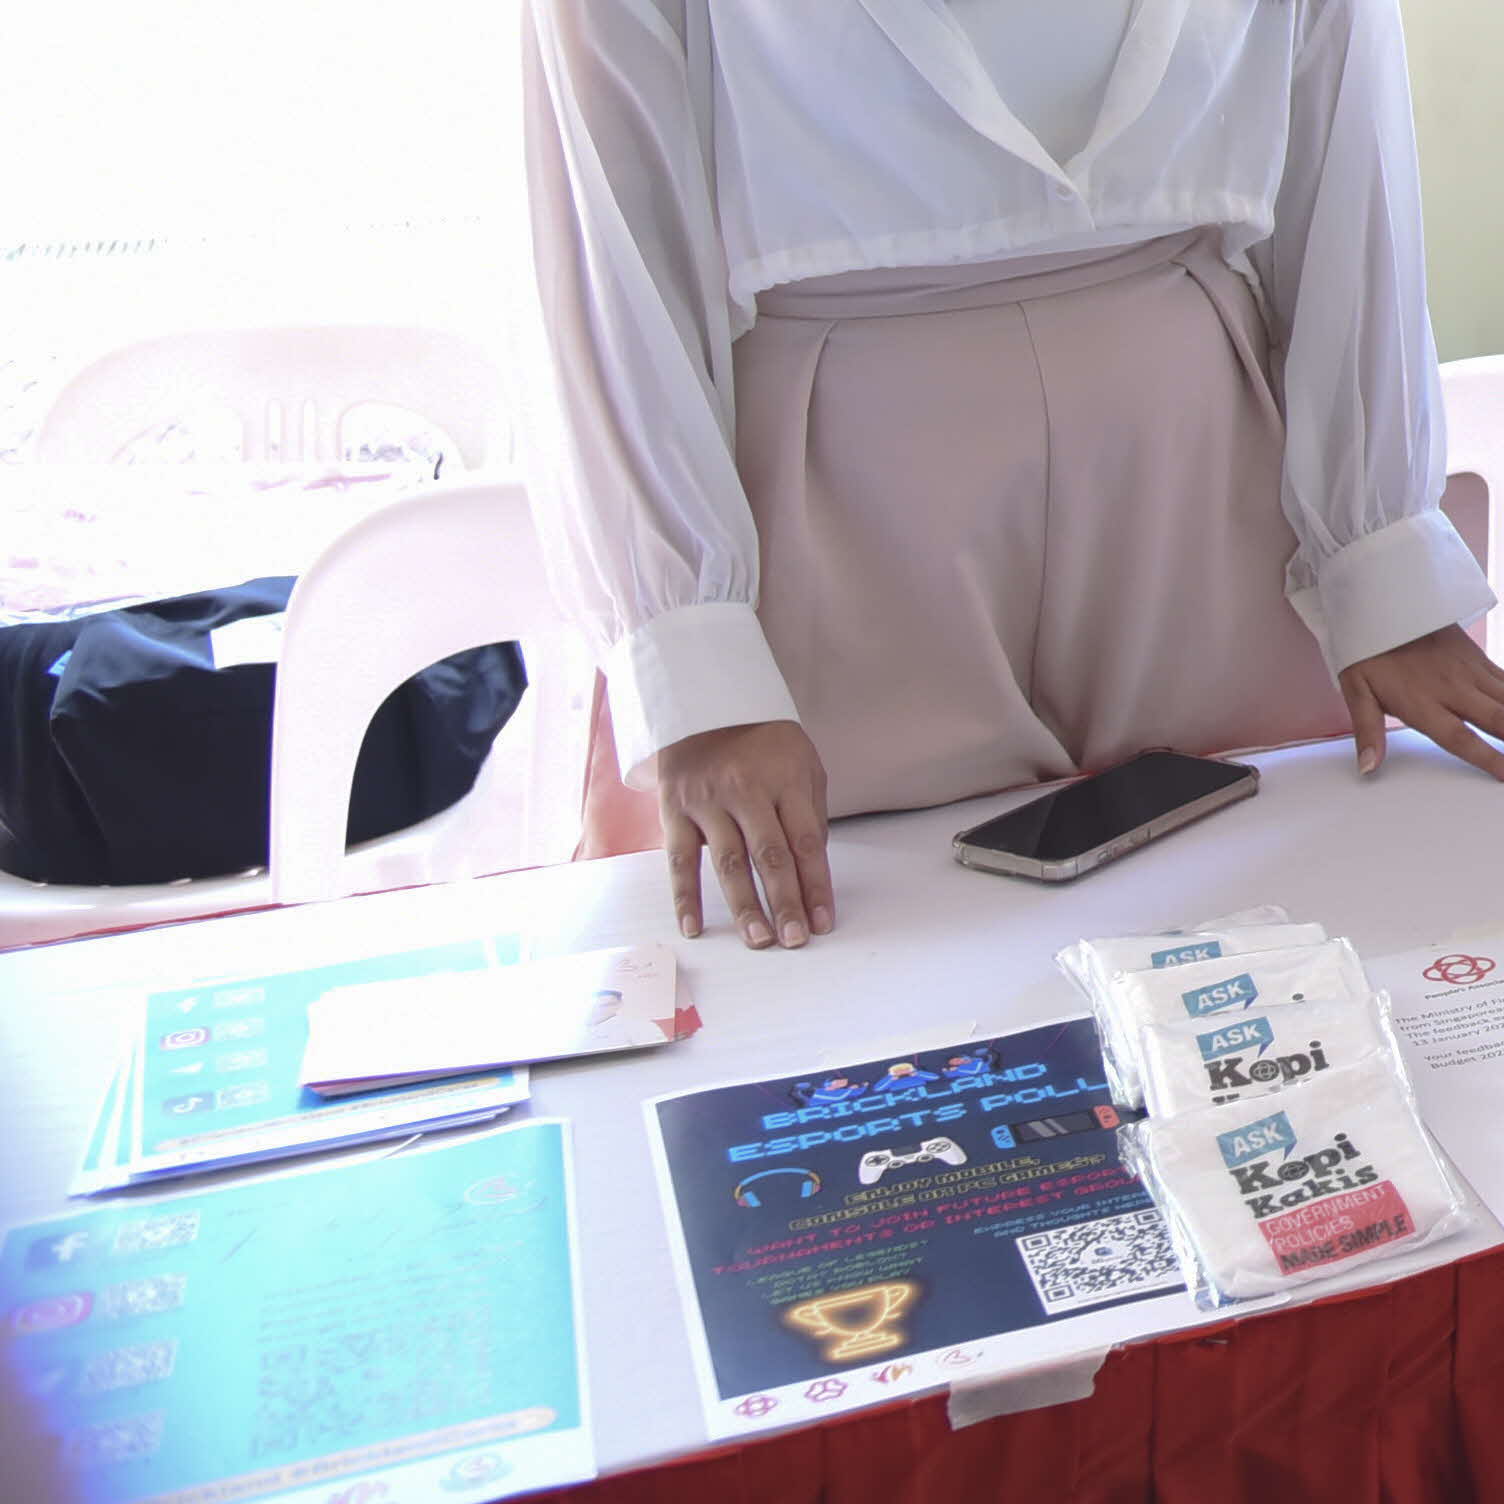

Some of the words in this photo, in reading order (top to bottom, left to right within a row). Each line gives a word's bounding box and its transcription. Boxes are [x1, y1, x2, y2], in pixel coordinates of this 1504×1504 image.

[1197, 982, 1246, 1009] ASK
[1421, 1004, 1473, 1021] Ministry
[1210, 1023, 1262, 1052] ASK
[1204, 1040, 1330, 1092] Kopi
[762, 1062, 1047, 1131] BRICKLAND
[728, 1102, 967, 1165] ESPORTS
[1231, 1121, 1286, 1158] ASK
[1229, 1132, 1361, 1195] Kopi
[1245, 1165, 1379, 1220] Kakis
[1265, 1184, 1387, 1236] GOVERNMENT
[1269, 1214, 1355, 1252] POLICIES
[1336, 1214, 1410, 1258] SIMPLE
